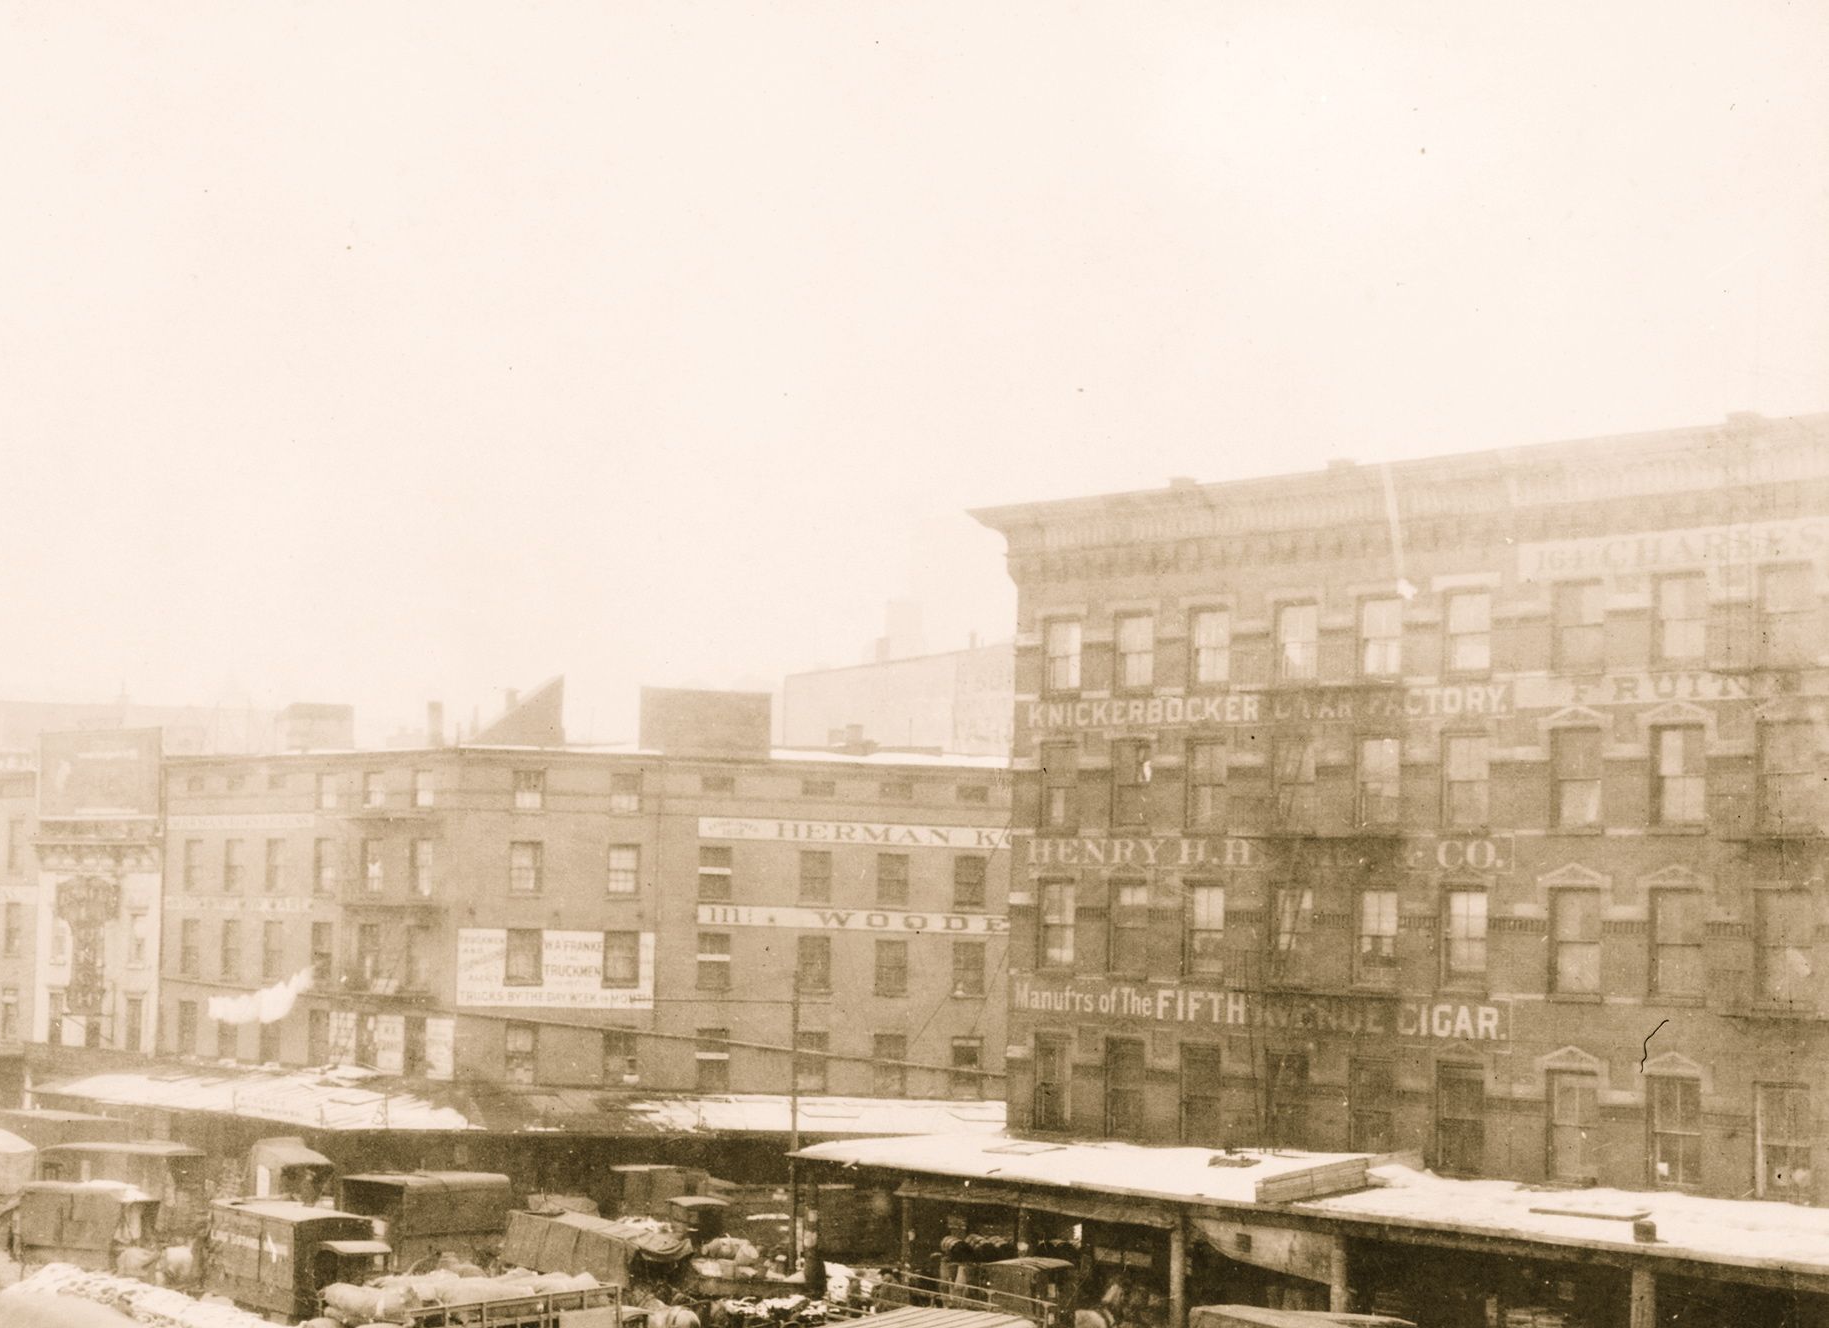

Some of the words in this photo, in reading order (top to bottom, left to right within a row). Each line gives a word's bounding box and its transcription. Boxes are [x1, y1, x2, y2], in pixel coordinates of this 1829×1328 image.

[1602, 523, 1825, 568] CHARLES
[1028, 695, 1260, 727] KNICKERBOCKER
[776, 822, 950, 847] HERMAN
[1028, 837, 1166, 866] HENRY
[1435, 839, 1507, 869] CO.
[814, 911, 1009, 933] WOODE
[545, 964, 602, 978] TRUCKMEN
[460, 990, 504, 1003] TRUCKS
[507, 991, 523, 1003] BY
[525, 991, 544, 1004] THE
[547, 992, 567, 1004] DAY
[1098, 988, 1118, 1015] of
[1119, 987, 1153, 1018] The
[1156, 989, 1247, 1024] FIFTH
[1396, 1002, 1508, 1041] CIGAR.
